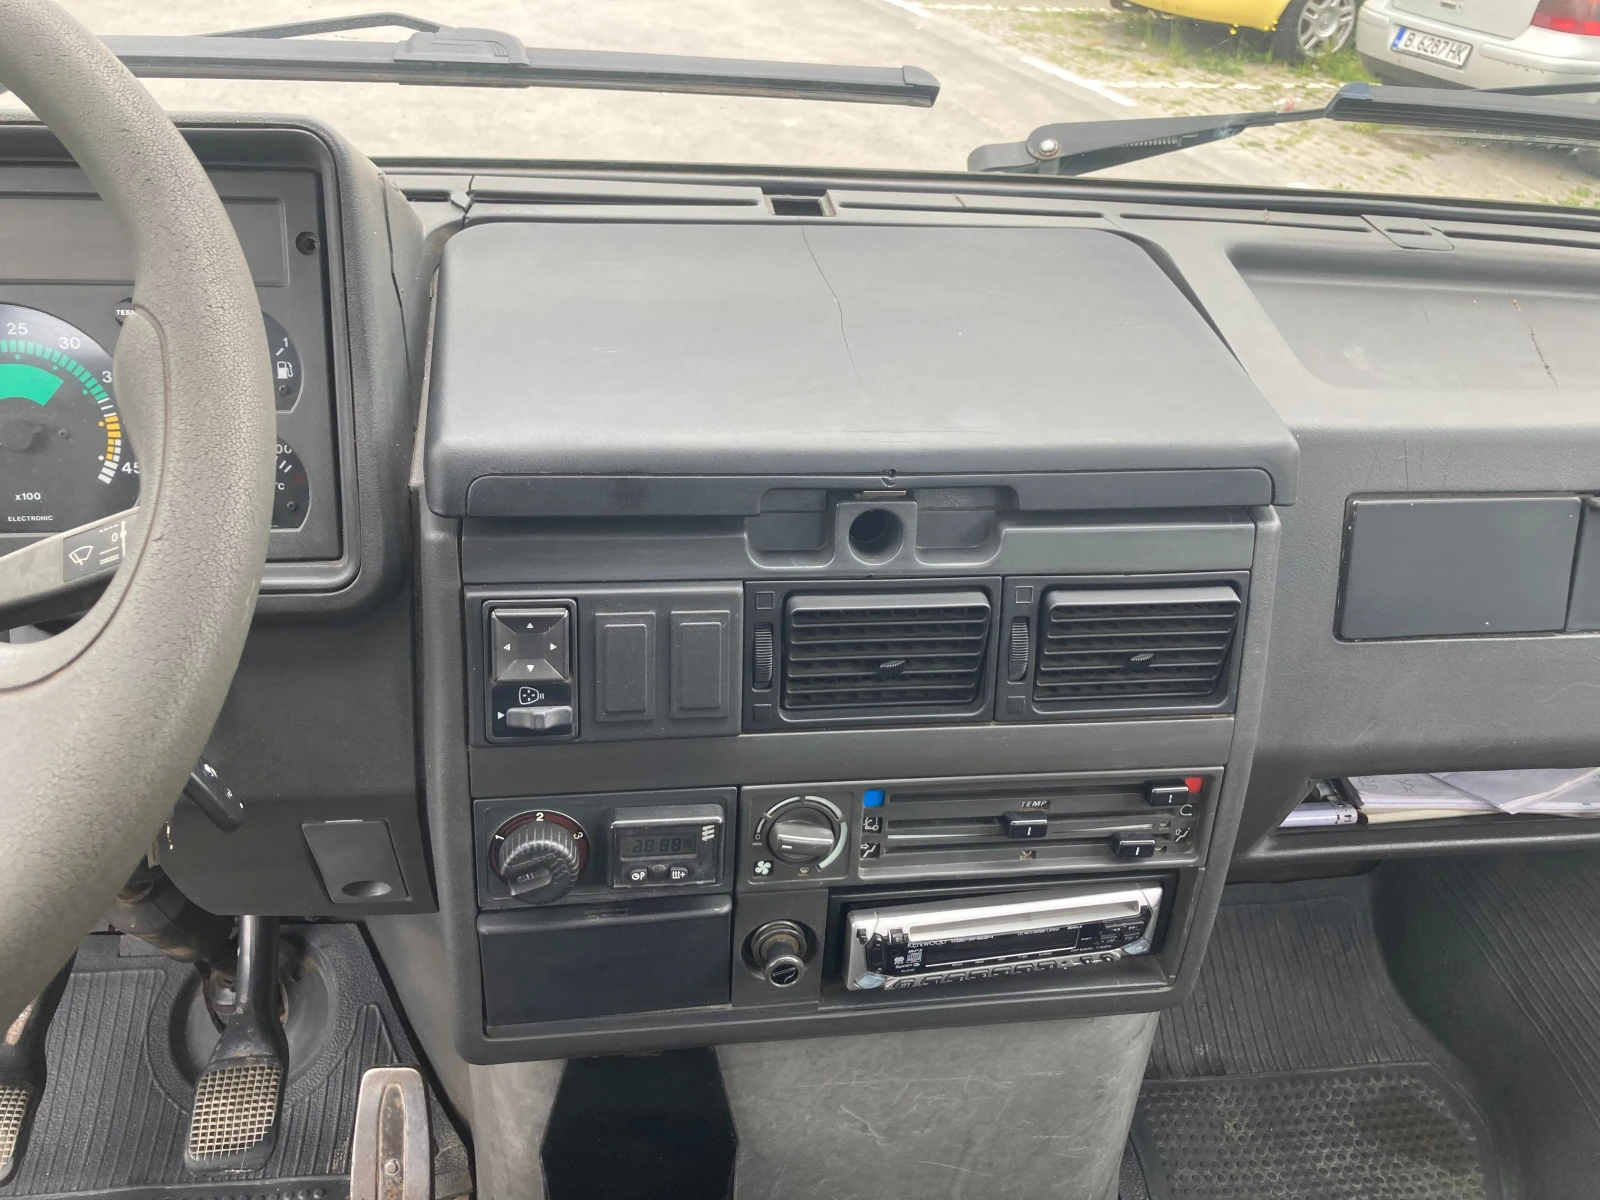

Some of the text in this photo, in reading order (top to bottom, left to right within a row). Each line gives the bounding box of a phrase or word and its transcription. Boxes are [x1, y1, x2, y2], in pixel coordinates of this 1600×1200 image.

[6, 322, 28, 336] 25
[58, 337, 81, 350] 30
[282, 337, 288, 348] 1
[102, 371, 113, 383] 3
[276, 444, 292, 454] 00
[121, 461, 140, 475] 45
[15, 492, 41, 502] x100
[111, 532, 118, 542] 0
[1020, 800, 1047, 808] TEMP
[535, 812, 544, 821] 2
[573, 831, 584, 840] 3
[907, 939, 947, 948] KENWOOD
